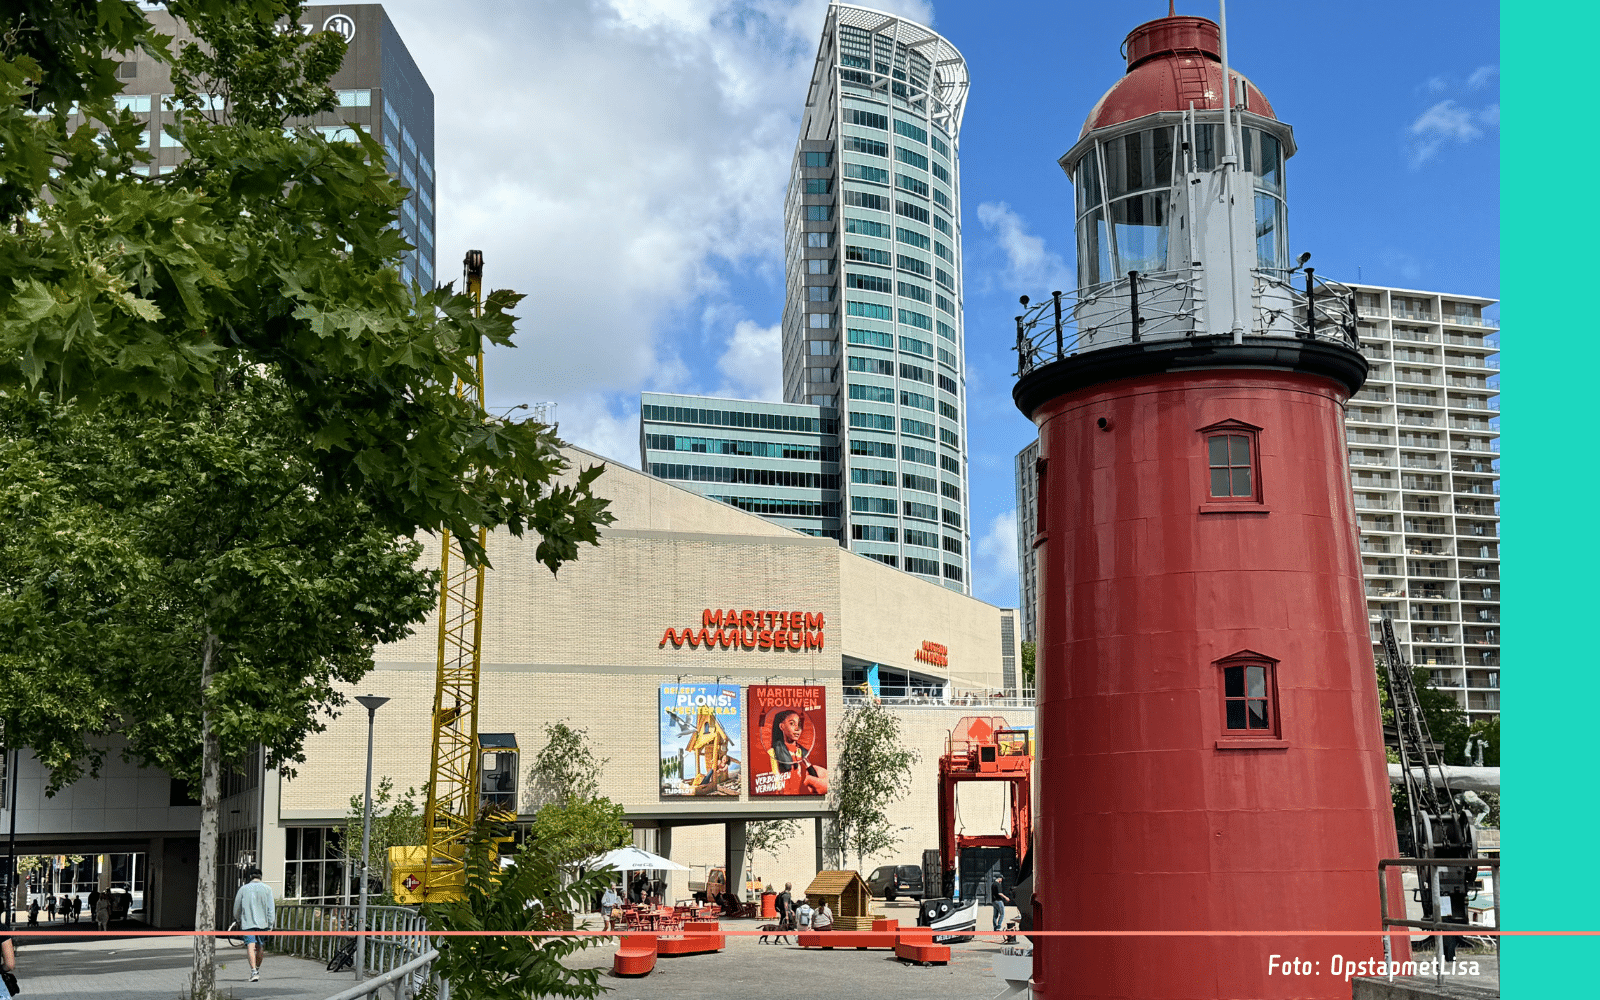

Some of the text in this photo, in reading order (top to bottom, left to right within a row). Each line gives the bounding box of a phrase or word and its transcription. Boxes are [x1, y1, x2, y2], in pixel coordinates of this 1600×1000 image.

[702, 609, 824, 629] MARITIEM
[659, 627, 824, 649] MUSEUM
[756, 688, 820, 698] MARITIEME
[677, 694, 732, 707] PLONS!
[758, 697, 818, 708] VROUWEN
